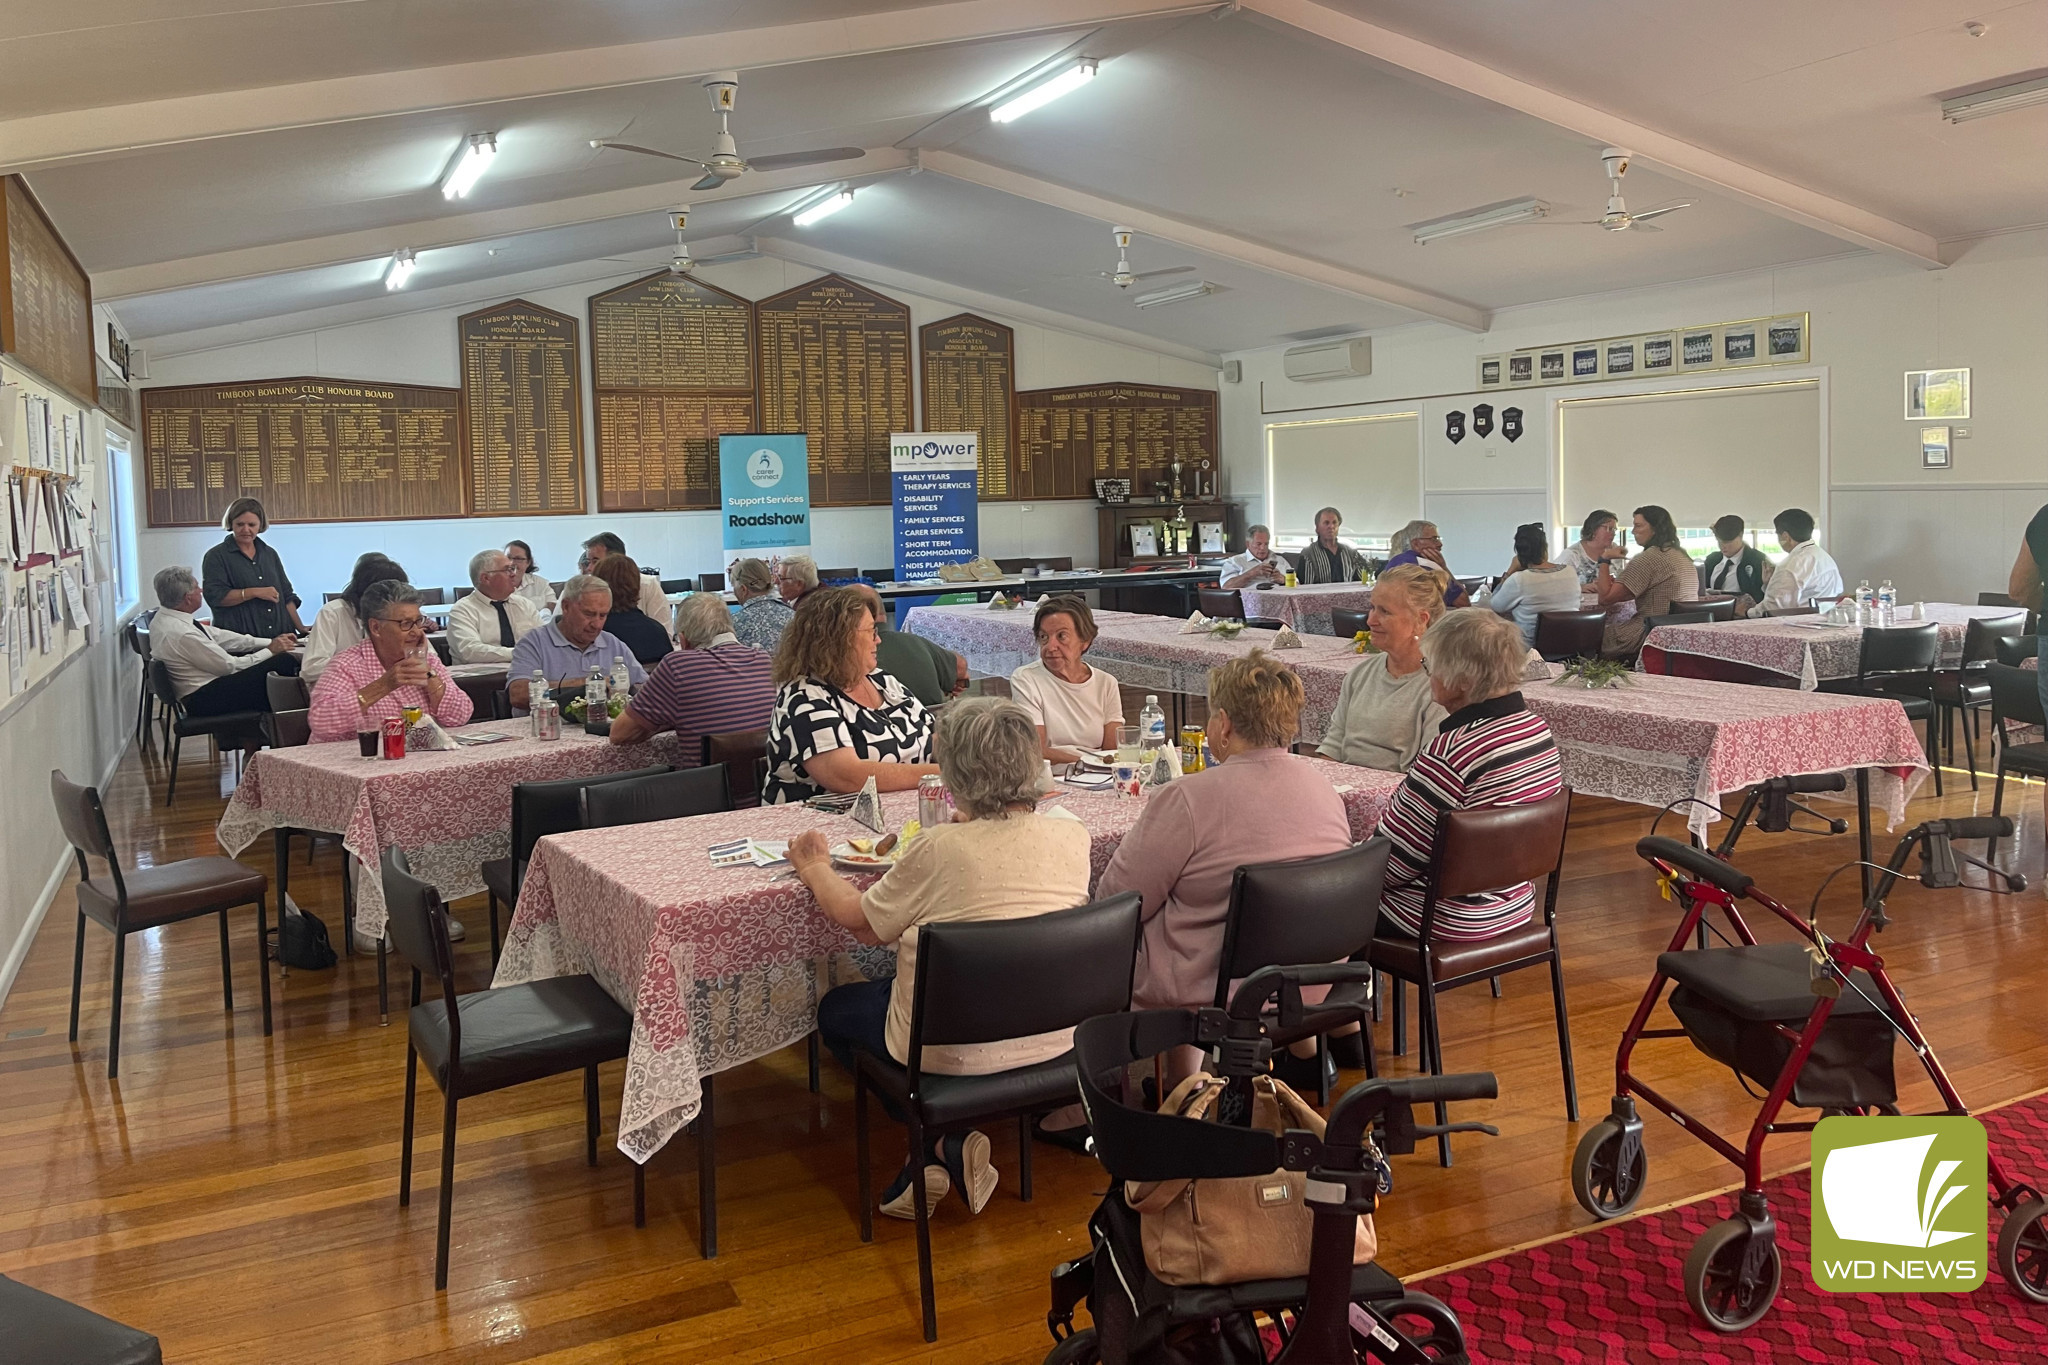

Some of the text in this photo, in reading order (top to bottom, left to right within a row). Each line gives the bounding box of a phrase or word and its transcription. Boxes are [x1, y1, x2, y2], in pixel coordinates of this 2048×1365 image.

[722, 90, 730, 104] 4
[679, 216, 685, 227] 2
[479, 314, 560, 327] TIMBOON BOWLING CLUB
[216, 385, 394, 400] TIMBOON BOWLING CLUB HONOUR BOARD
[1052, 393, 1077, 402] TIMBOON
[1078, 391, 1097, 399] BOWLS
[1099, 388, 1114, 397] CLUB
[1137, 390, 1161, 399] HONOUR
[1162, 392, 1181, 401] BOARD
[893, 441, 975, 460] mpower
[751, 473, 779, 481] connect
[938, 482, 972, 490] SERVICES
[728, 494, 804, 507] Support Services
[903, 494, 944, 503] DISABILITY
[904, 504, 938, 512] SERVICES
[729, 512, 805, 528] Roadshow
[904, 515, 966, 524] FAMILY SERVICES
[904, 529, 929, 537] CARER
[905, 541, 930, 549] SHORT
[905, 548, 972, 557] ACCOMMODATION
[905, 570, 940, 579] MANAGE
